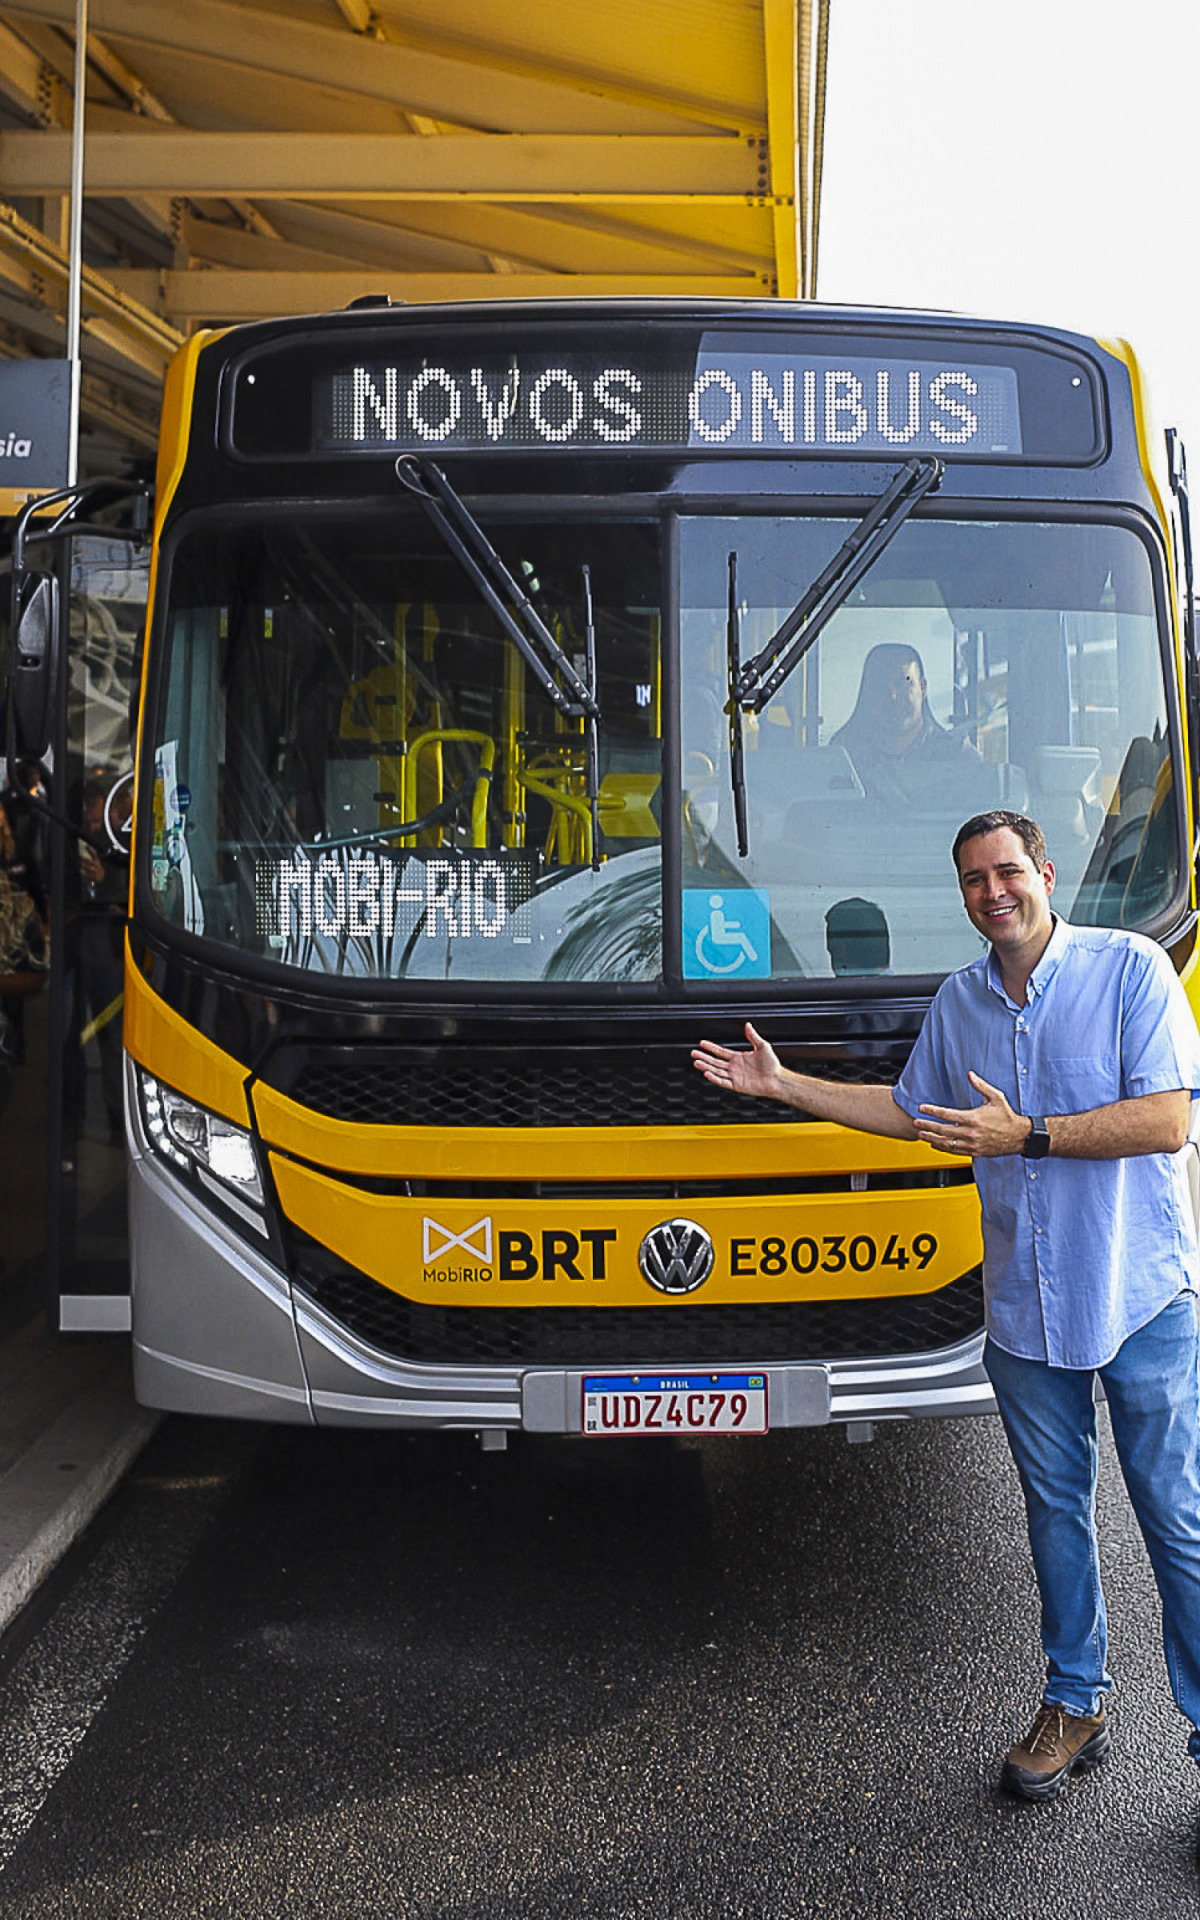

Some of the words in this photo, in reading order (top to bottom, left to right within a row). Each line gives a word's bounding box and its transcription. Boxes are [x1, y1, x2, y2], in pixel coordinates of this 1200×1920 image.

[354, 367, 641, 441] NOVOS
[688, 369, 979, 444] ONIBUS
[280, 859, 505, 938] MOBI-RIO
[423, 1268, 493, 1283] MobiRIO
[499, 1229, 617, 1281] BRT
[730, 1233, 938, 1276] E803049
[660, 1380, 689, 1389] BRASIL
[601, 1394, 747, 1428] UDZ4C79
